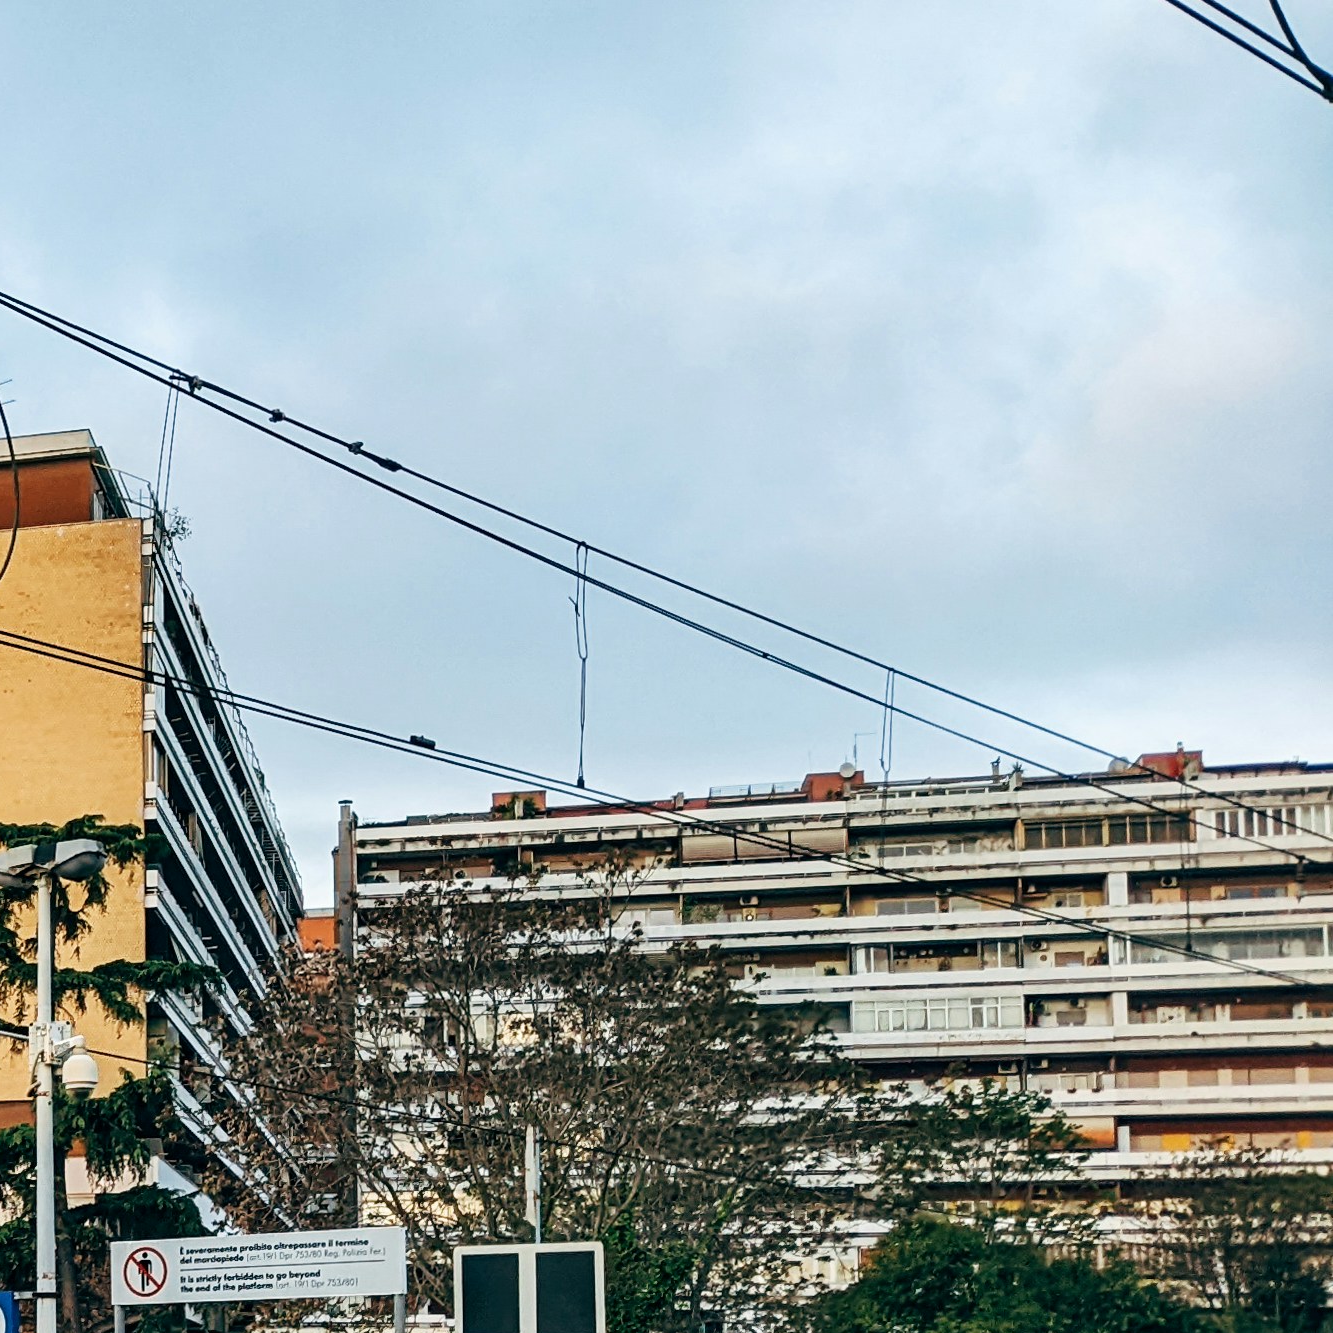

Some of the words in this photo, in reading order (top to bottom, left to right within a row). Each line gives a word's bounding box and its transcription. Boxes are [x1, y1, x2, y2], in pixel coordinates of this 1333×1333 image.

[186, 1244, 237, 1255] severamente
[239, 1242, 272, 1253] proibito
[274, 1241, 326, 1251] oltrepassare
[328, 1239, 334, 1248] il
[335, 1238, 369, 1247] termine
[180, 1256, 192, 1265] del
[194, 1253, 244, 1264] marciapiede
[180, 1275, 186, 1284] It
[187, 1275, 194, 1283] is
[196, 1273, 221, 1284] strictly
[224, 1271, 264, 1282] forbidden
[266, 1271, 274, 1280] to
[276, 1272, 287, 1281] go
[289, 1270, 321, 1280] beyond
[180, 1284, 193, 1293] the
[195, 1284, 210, 1292] end
[212, 1283, 221, 1292] of
[223, 1283, 235, 1291] the
[238, 1281, 273, 1293] platform
